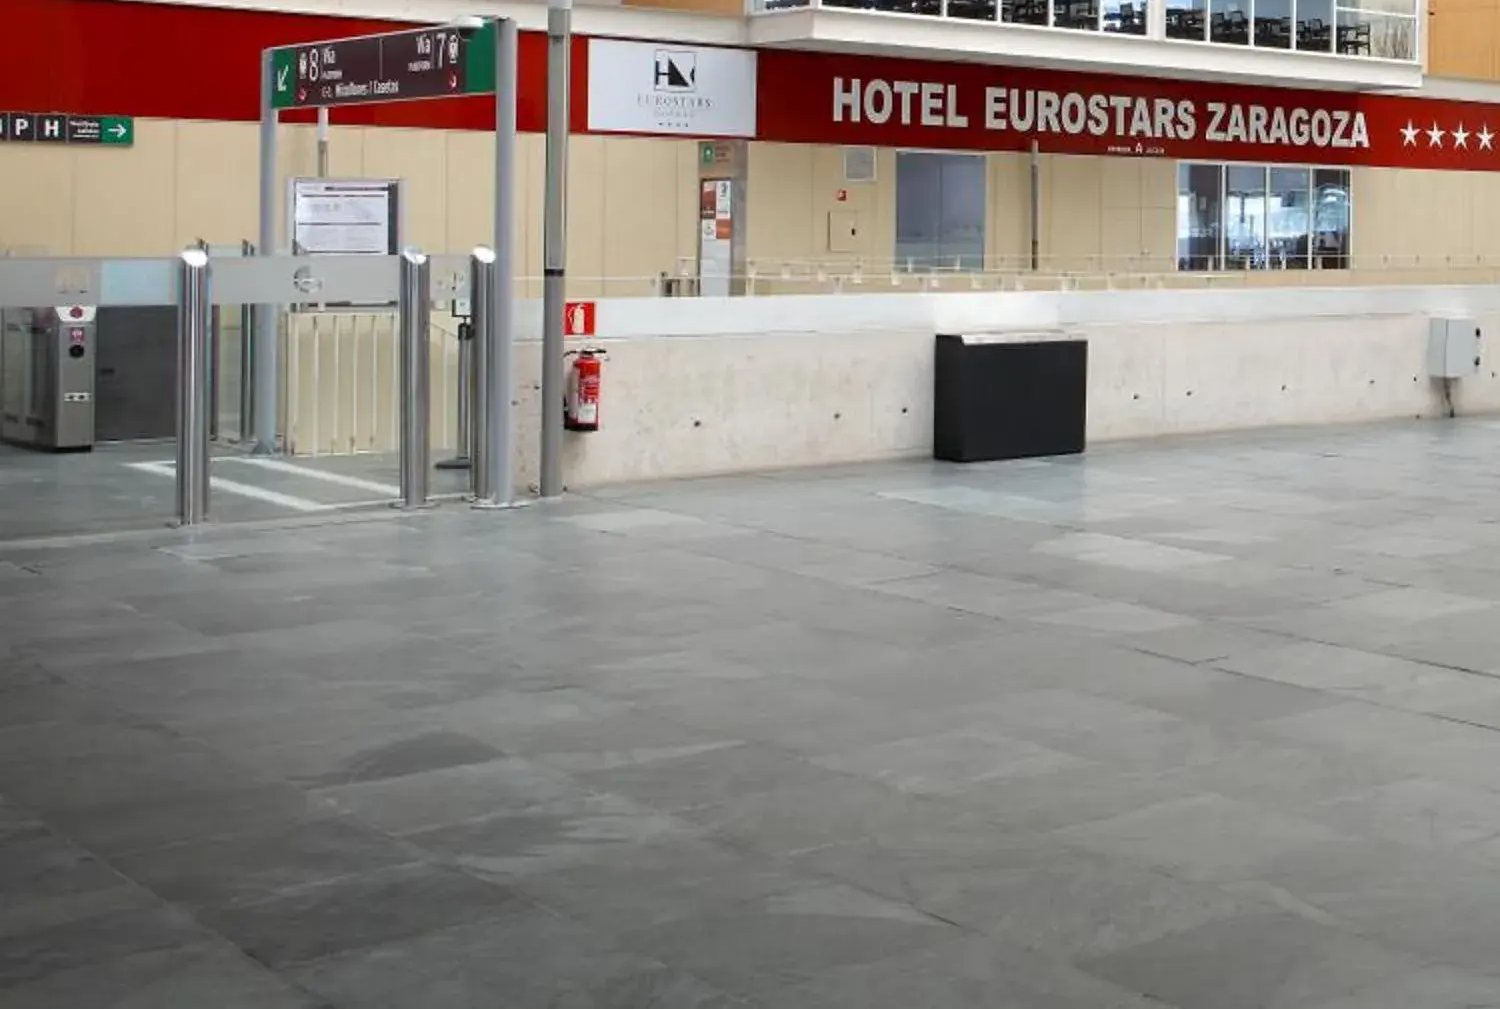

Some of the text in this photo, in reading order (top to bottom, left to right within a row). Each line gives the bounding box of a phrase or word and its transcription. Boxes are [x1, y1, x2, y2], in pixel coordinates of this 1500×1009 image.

[309, 48, 319, 82] 8
[436, 32, 447, 69] 7
[15, 118, 29, 136] P
[45, 119, 59, 137] H
[833, 77, 1370, 148] HOTEL EUROSTARS ZARAGOZA
